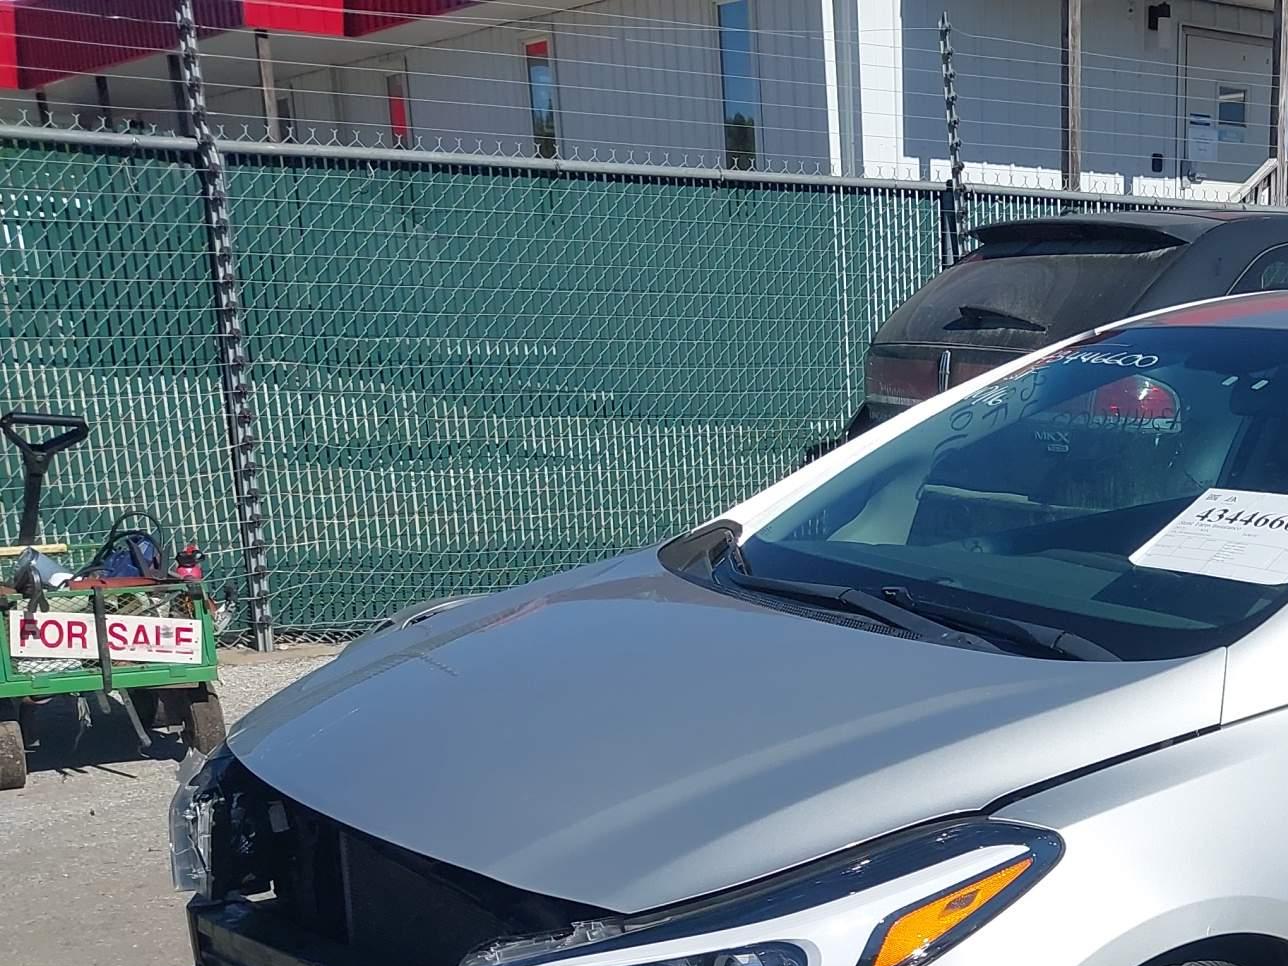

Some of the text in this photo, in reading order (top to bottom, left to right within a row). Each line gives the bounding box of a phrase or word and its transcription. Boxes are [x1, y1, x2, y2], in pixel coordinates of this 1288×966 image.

[1033, 431, 1069, 444] MKX
[19, 618, 194, 655] FOR SALE
